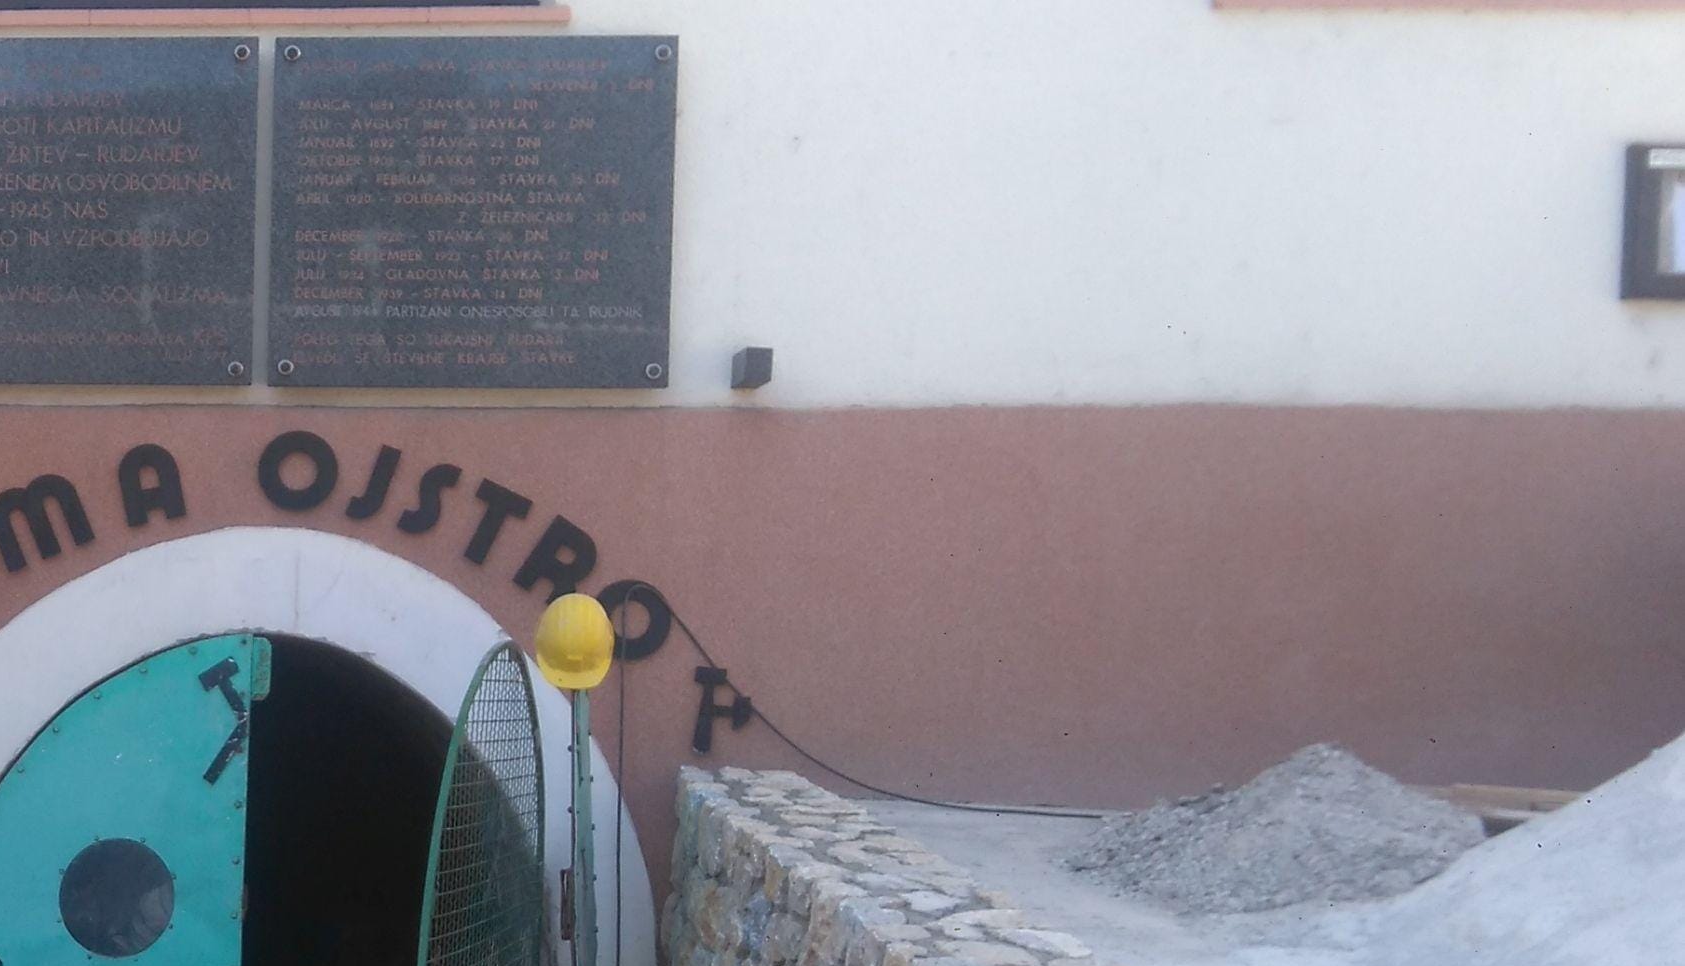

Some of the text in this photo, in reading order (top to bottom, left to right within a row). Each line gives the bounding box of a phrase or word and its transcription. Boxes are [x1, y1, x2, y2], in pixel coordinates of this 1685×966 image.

[418, 99, 475, 111] STAVKA
[514, 99, 539, 111] DNI
[46, 118, 182, 135] KAPITALIZMU
[351, 118, 410, 130] AVGUST
[469, 118, 527, 130] STAVKA
[517, 137, 541, 149] DNI
[6, 142, 66, 163] ŽRTEV
[96, 146, 200, 163] RUDARJEV
[515, 155, 539, 167] DNI
[66, 174, 232, 191] OSVOBODILNEM
[498, 173, 557, 186] STAVKA
[427, 230, 484, 242] STAVKA
[485, 250, 543, 262] STAVKA
[385, 269, 469, 280] GLADOVNA
[483, 269, 540, 280] STAVKA
[424, 288, 481, 300] STAVKA
[386, 306, 451, 318] PARTIZANI
[589, 306, 642, 318] RUDNIK
[256, 429, 671, 661] OJSTRO
